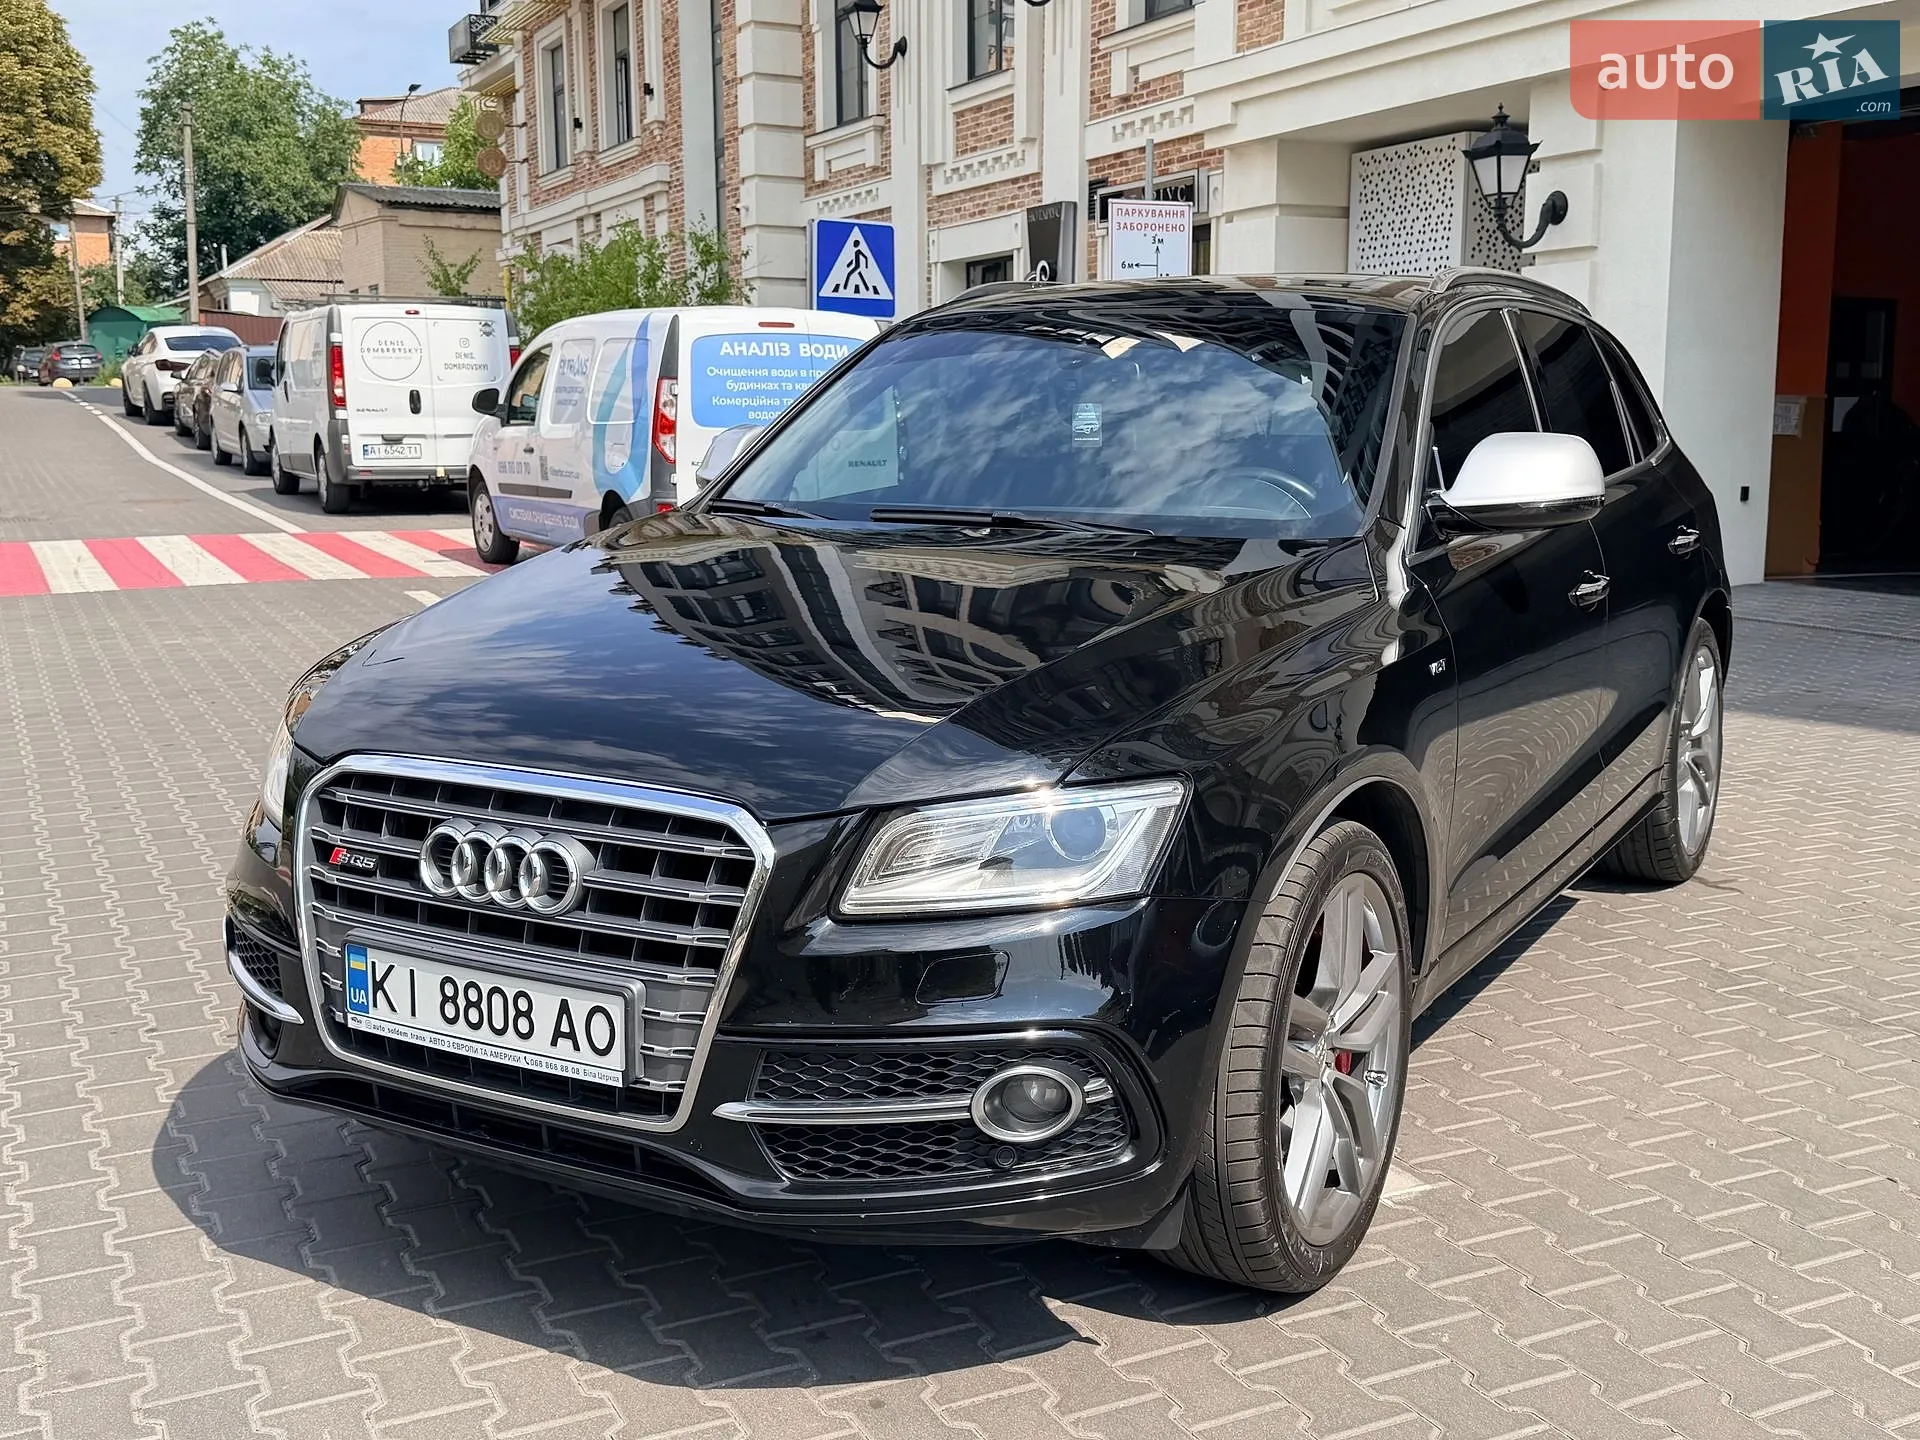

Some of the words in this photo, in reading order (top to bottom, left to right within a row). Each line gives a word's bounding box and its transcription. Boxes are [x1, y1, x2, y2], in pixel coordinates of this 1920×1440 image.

[1116, 207, 1185, 219] ПАРКУВАННЯ
[1116, 221, 1186, 233] ЗАБОРОНЕНО
[378, 339, 405, 348] DENIS
[719, 341, 791, 357] АНАЛІЗ
[799, 343, 849, 361] ВОДИ
[706, 366, 769, 379] Очищення
[771, 368, 798, 379] води
[726, 379, 780, 394] будинках
[781, 382, 793, 391] та
[712, 395, 780, 410] Комерційна
[847, 458, 888, 468] RENAULT
[333, 850, 377, 869] SQ5
[350, 987, 367, 1006] UA
[370, 959, 418, 1018] KI
[438, 975, 536, 1041] 8808
[549, 998, 617, 1058] AO
[428, 1036, 446, 1047] АВТО
[452, 1041, 479, 1055] ЄВРОПИ
[480, 1048, 489, 1057] ТА
[489, 1050, 521, 1063] АМЕРИКИ
